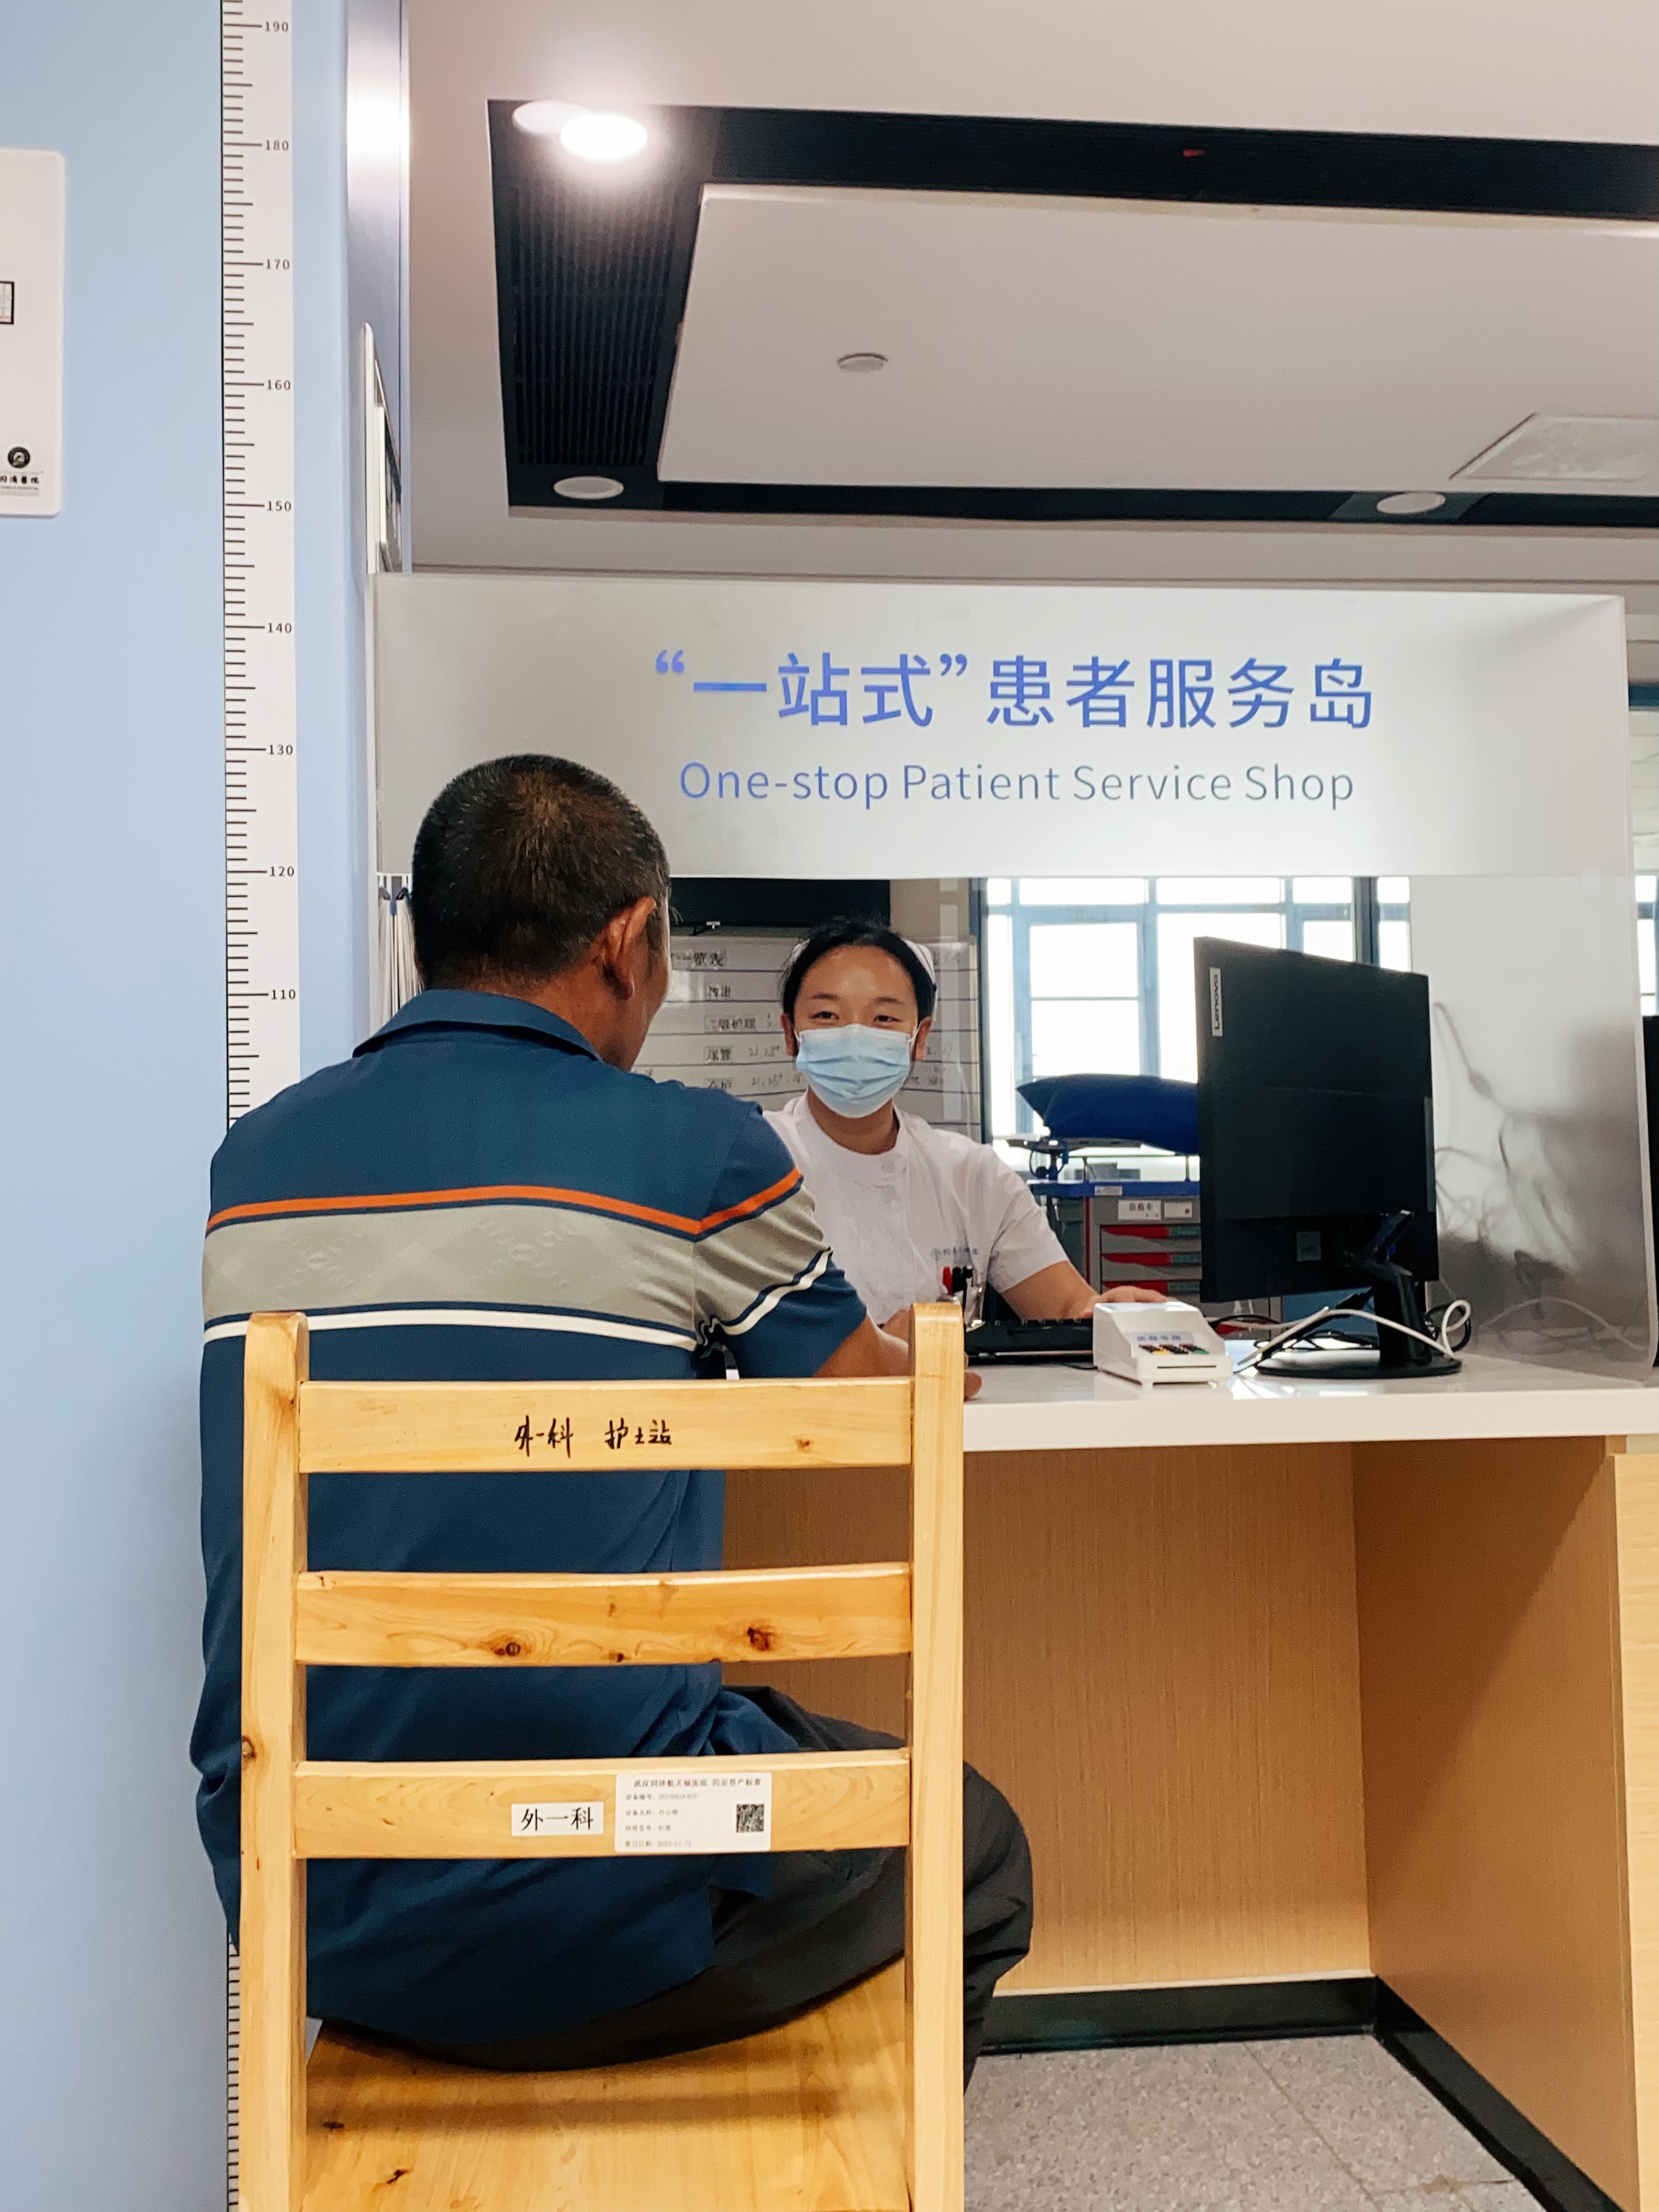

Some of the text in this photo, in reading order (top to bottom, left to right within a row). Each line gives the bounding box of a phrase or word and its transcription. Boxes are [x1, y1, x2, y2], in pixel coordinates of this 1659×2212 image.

[266, 21, 289, 32] 190
[266, 140, 289, 151] 180
[266, 259, 290, 270] 170
[267, 380, 291, 391] 160
[267, 500, 291, 512] 150
[268, 622, 292, 634] 140
[268, 744, 293, 756] 130
[680, 762, 1354, 810] One-stop Patient Service Shop
[270, 866, 294, 877] 120
[271, 988, 296, 1000] 110
[604, 1416, 672, 1450] 护士站
[521, 1806, 594, 1831] 外一科
